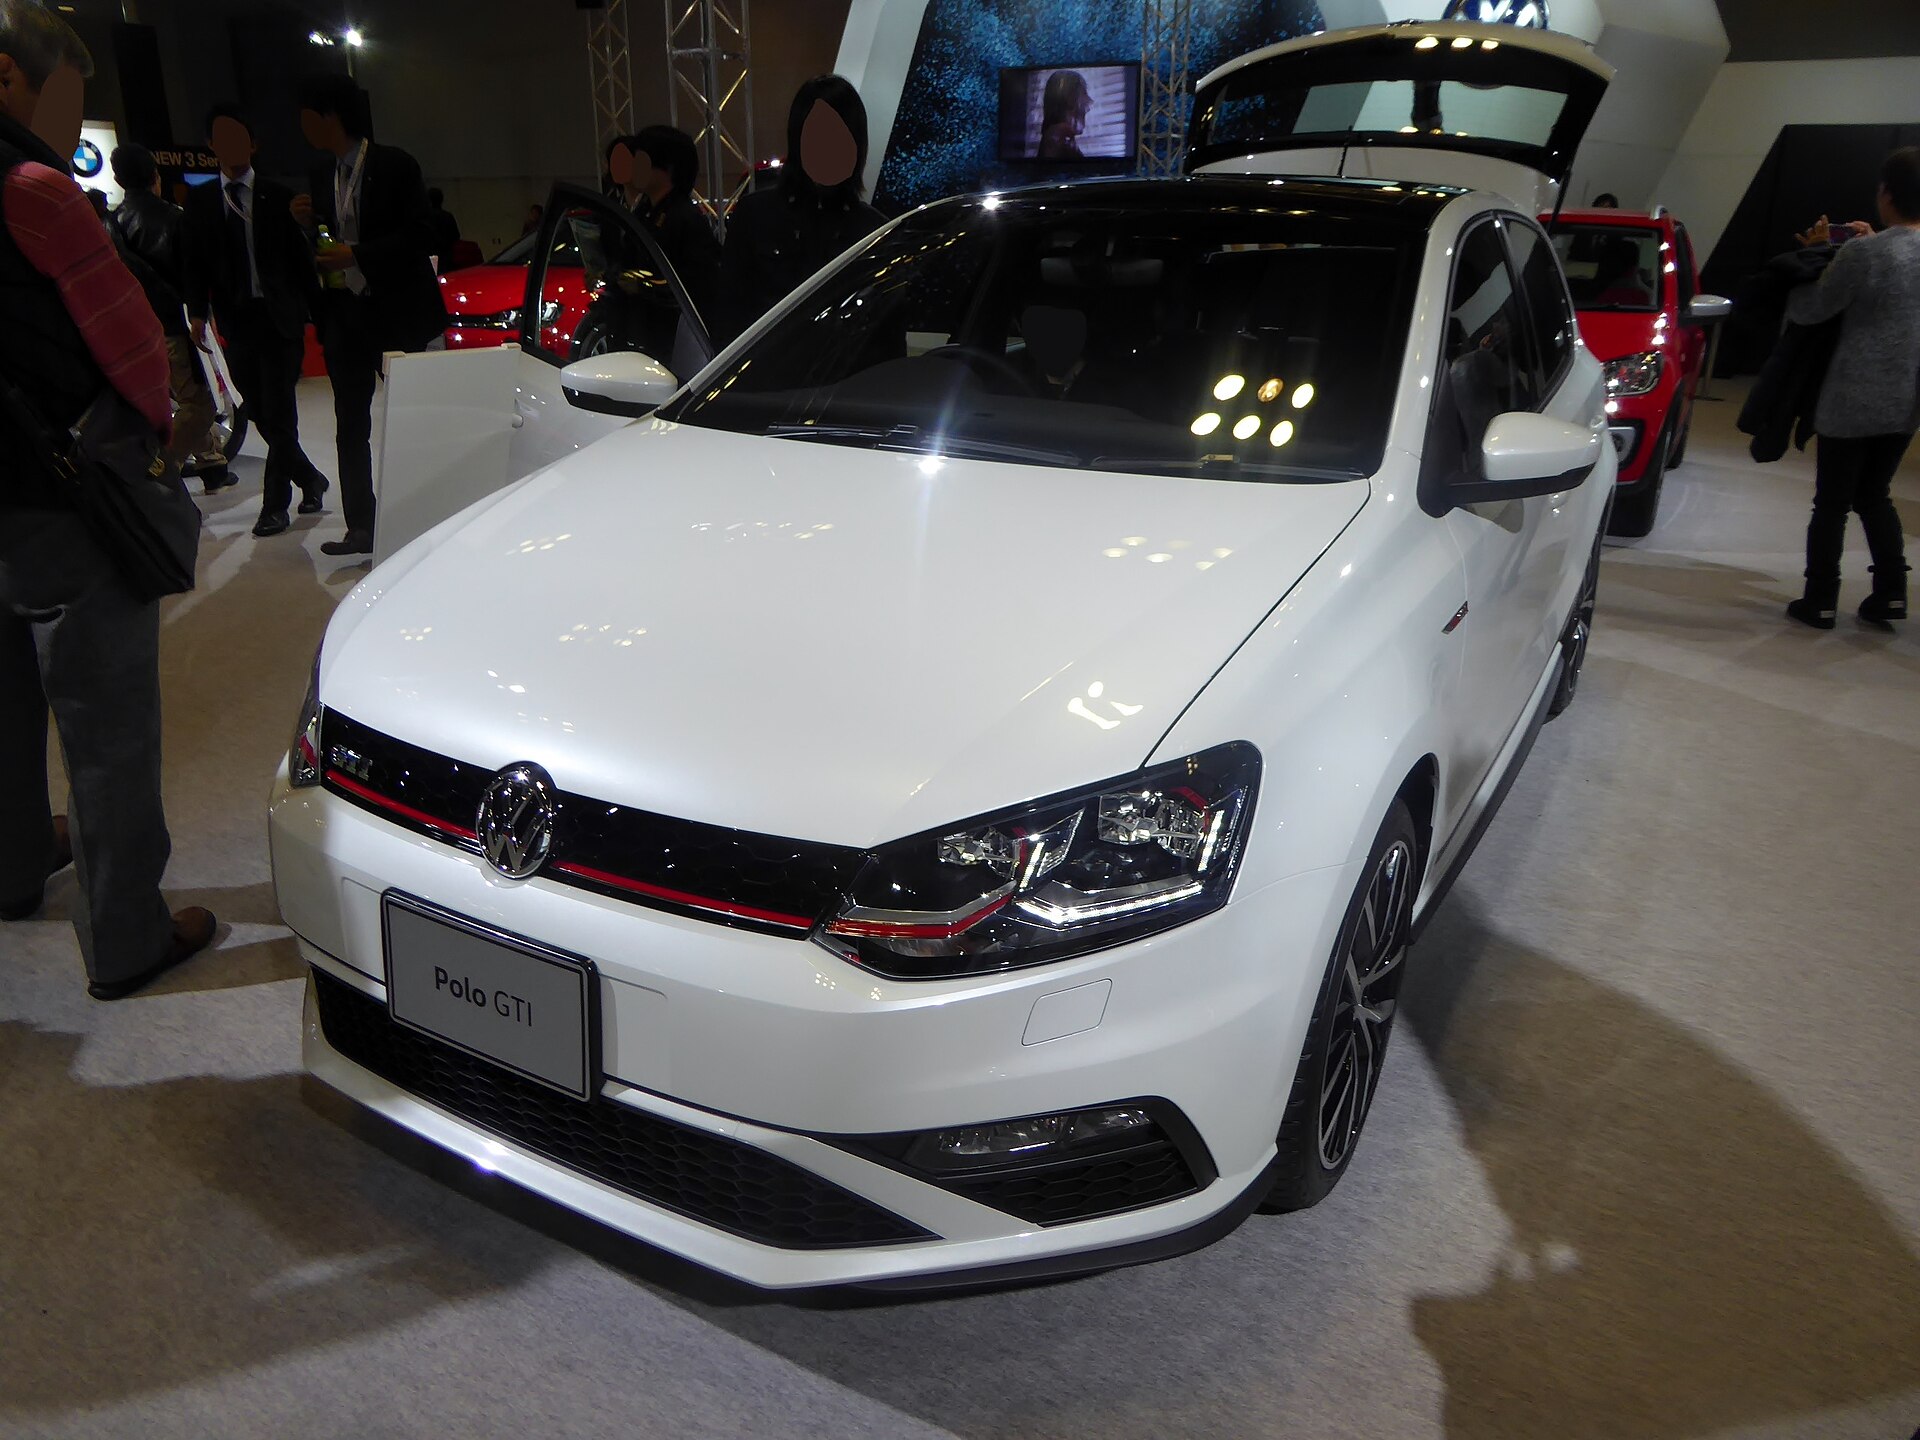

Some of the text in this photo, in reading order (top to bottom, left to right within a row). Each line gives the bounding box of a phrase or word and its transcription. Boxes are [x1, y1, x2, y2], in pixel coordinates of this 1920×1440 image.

[153, 151, 182, 166] NEW
[185, 152, 196, 167] 3
[434, 965, 532, 1027] Polo GTI
